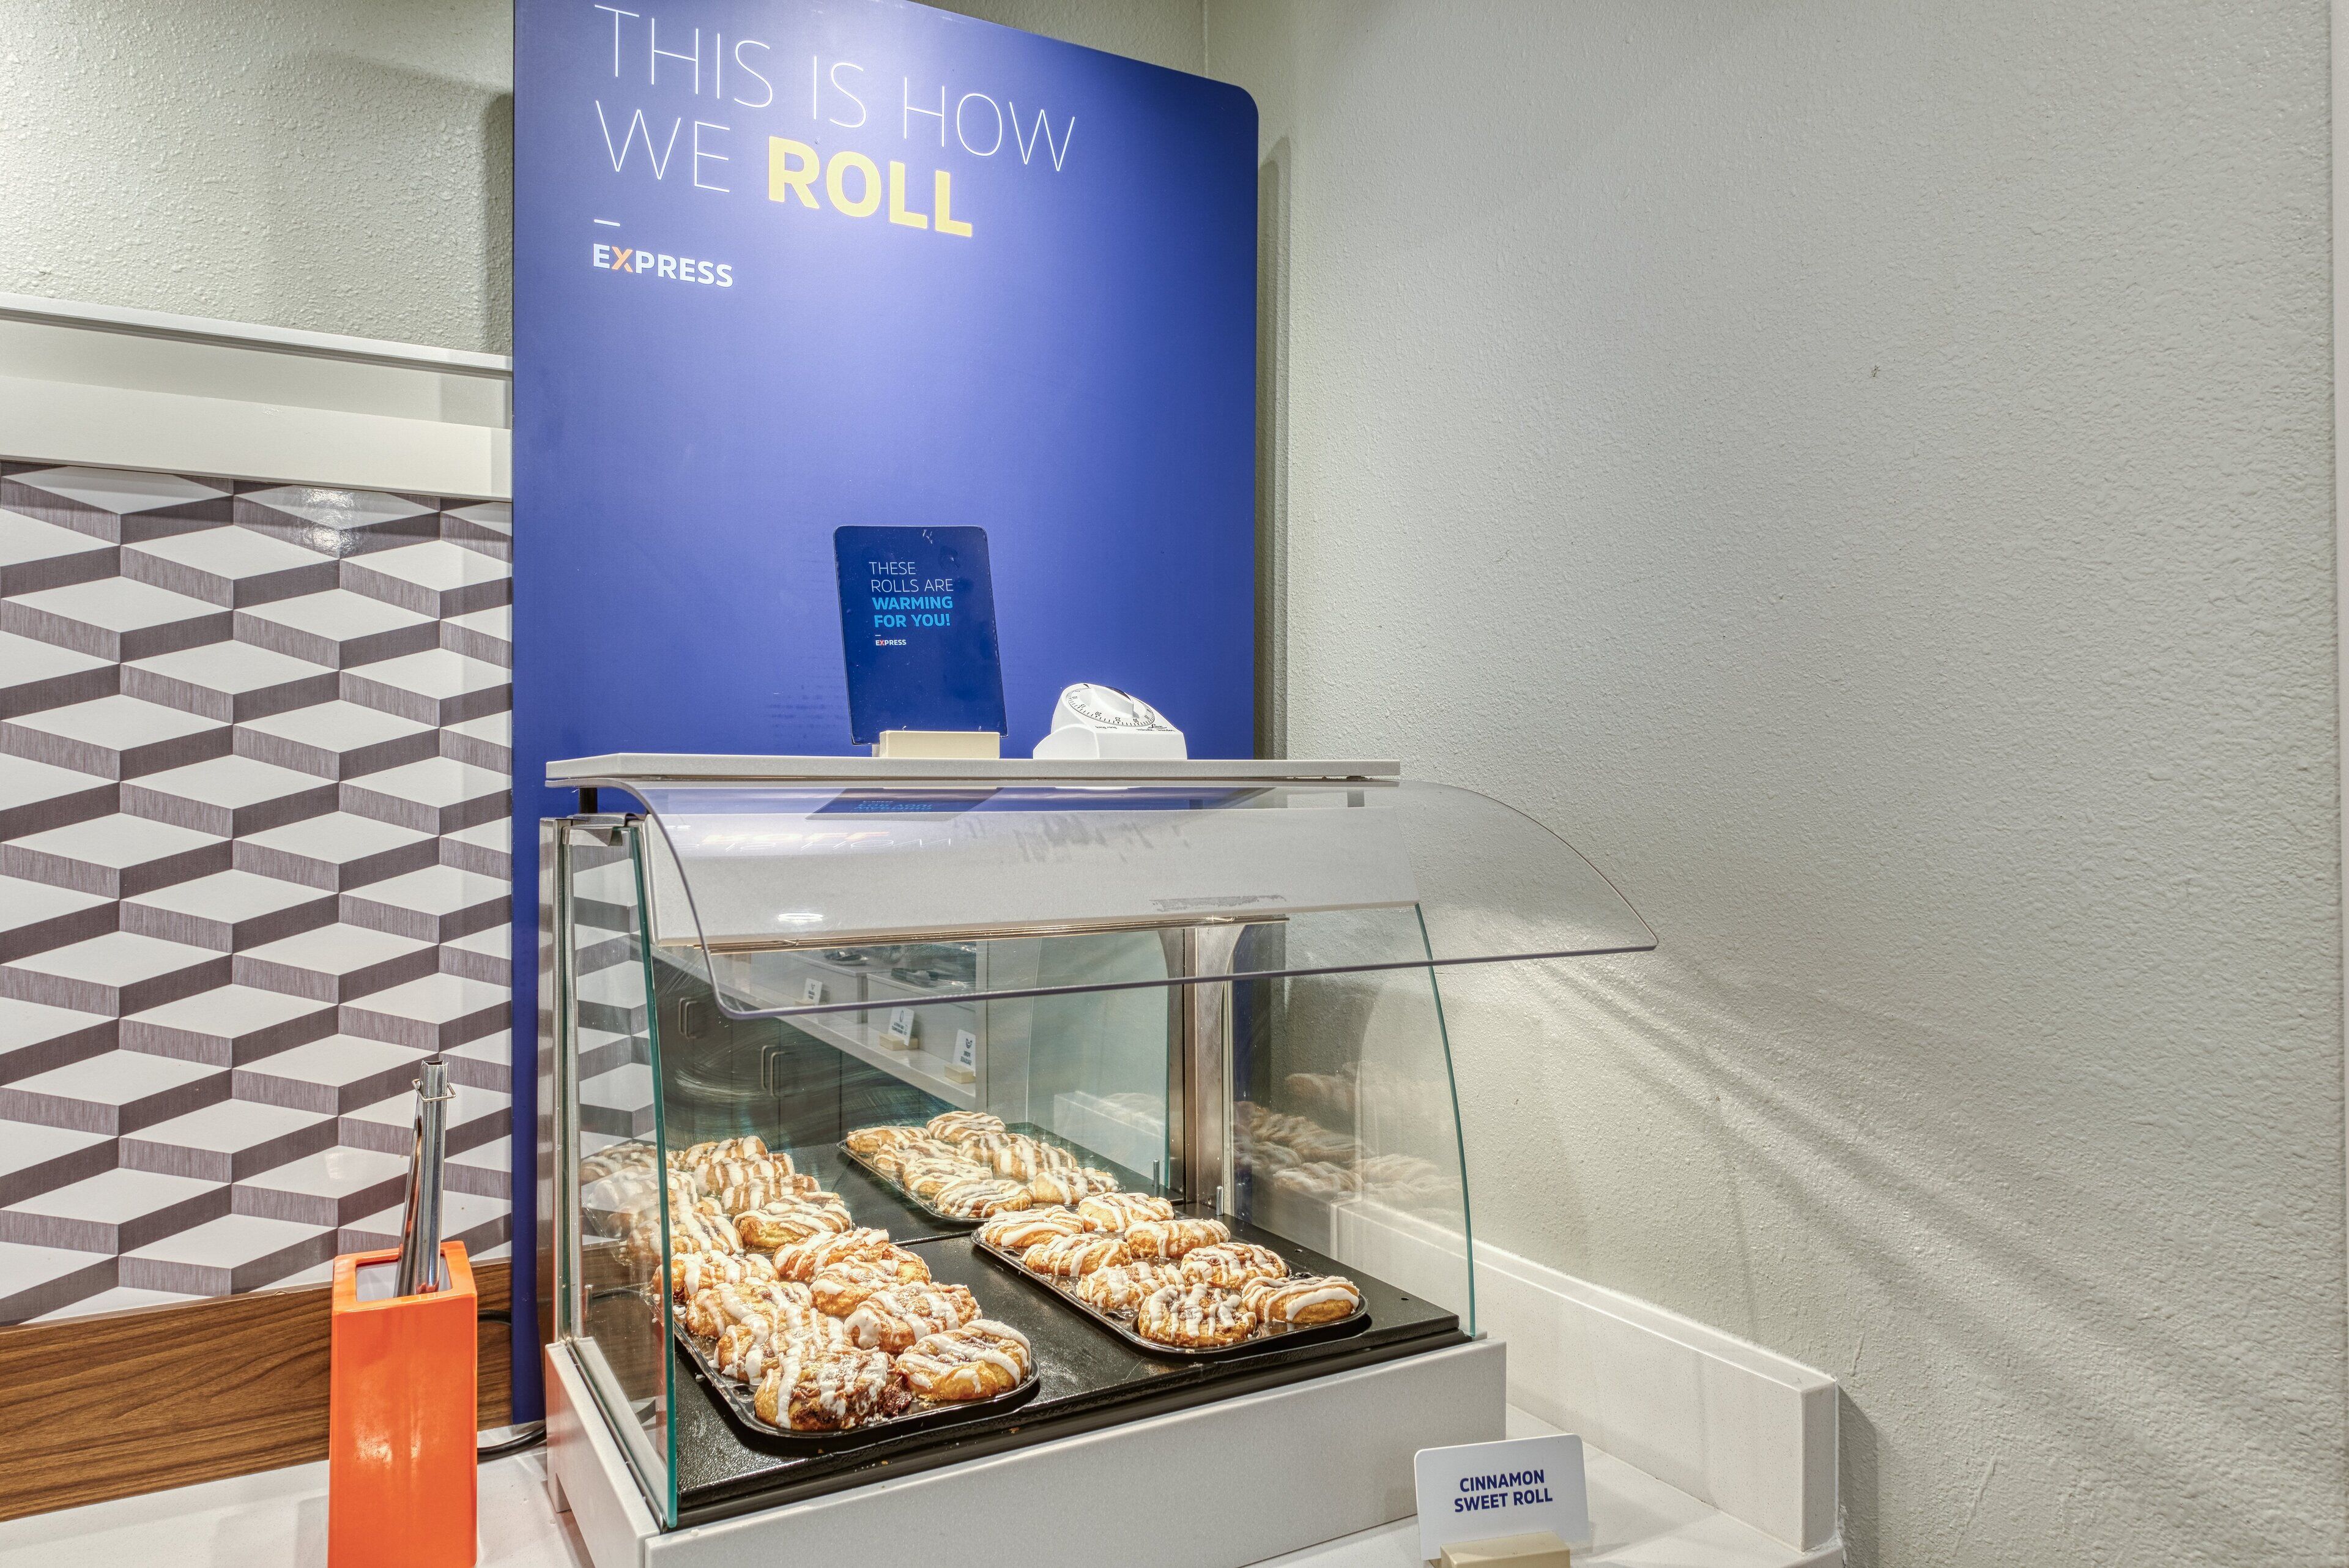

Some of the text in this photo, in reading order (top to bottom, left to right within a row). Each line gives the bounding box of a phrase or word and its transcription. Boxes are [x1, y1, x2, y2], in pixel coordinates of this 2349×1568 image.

[595, 4, 1075, 172] THIS IS HOW
[596, 100, 973, 238] WE ROLL
[593, 243, 733, 288] EXPRESS
[869, 562, 916, 575] THESE
[871, 578, 954, 593] ROLLS ARE
[872, 596, 953, 611] WARMING
[874, 614, 951, 628] FOR YOU!
[1460, 1469, 1545, 1493] CINNAMON
[1455, 1488, 1553, 1513] SWEET ROLL
